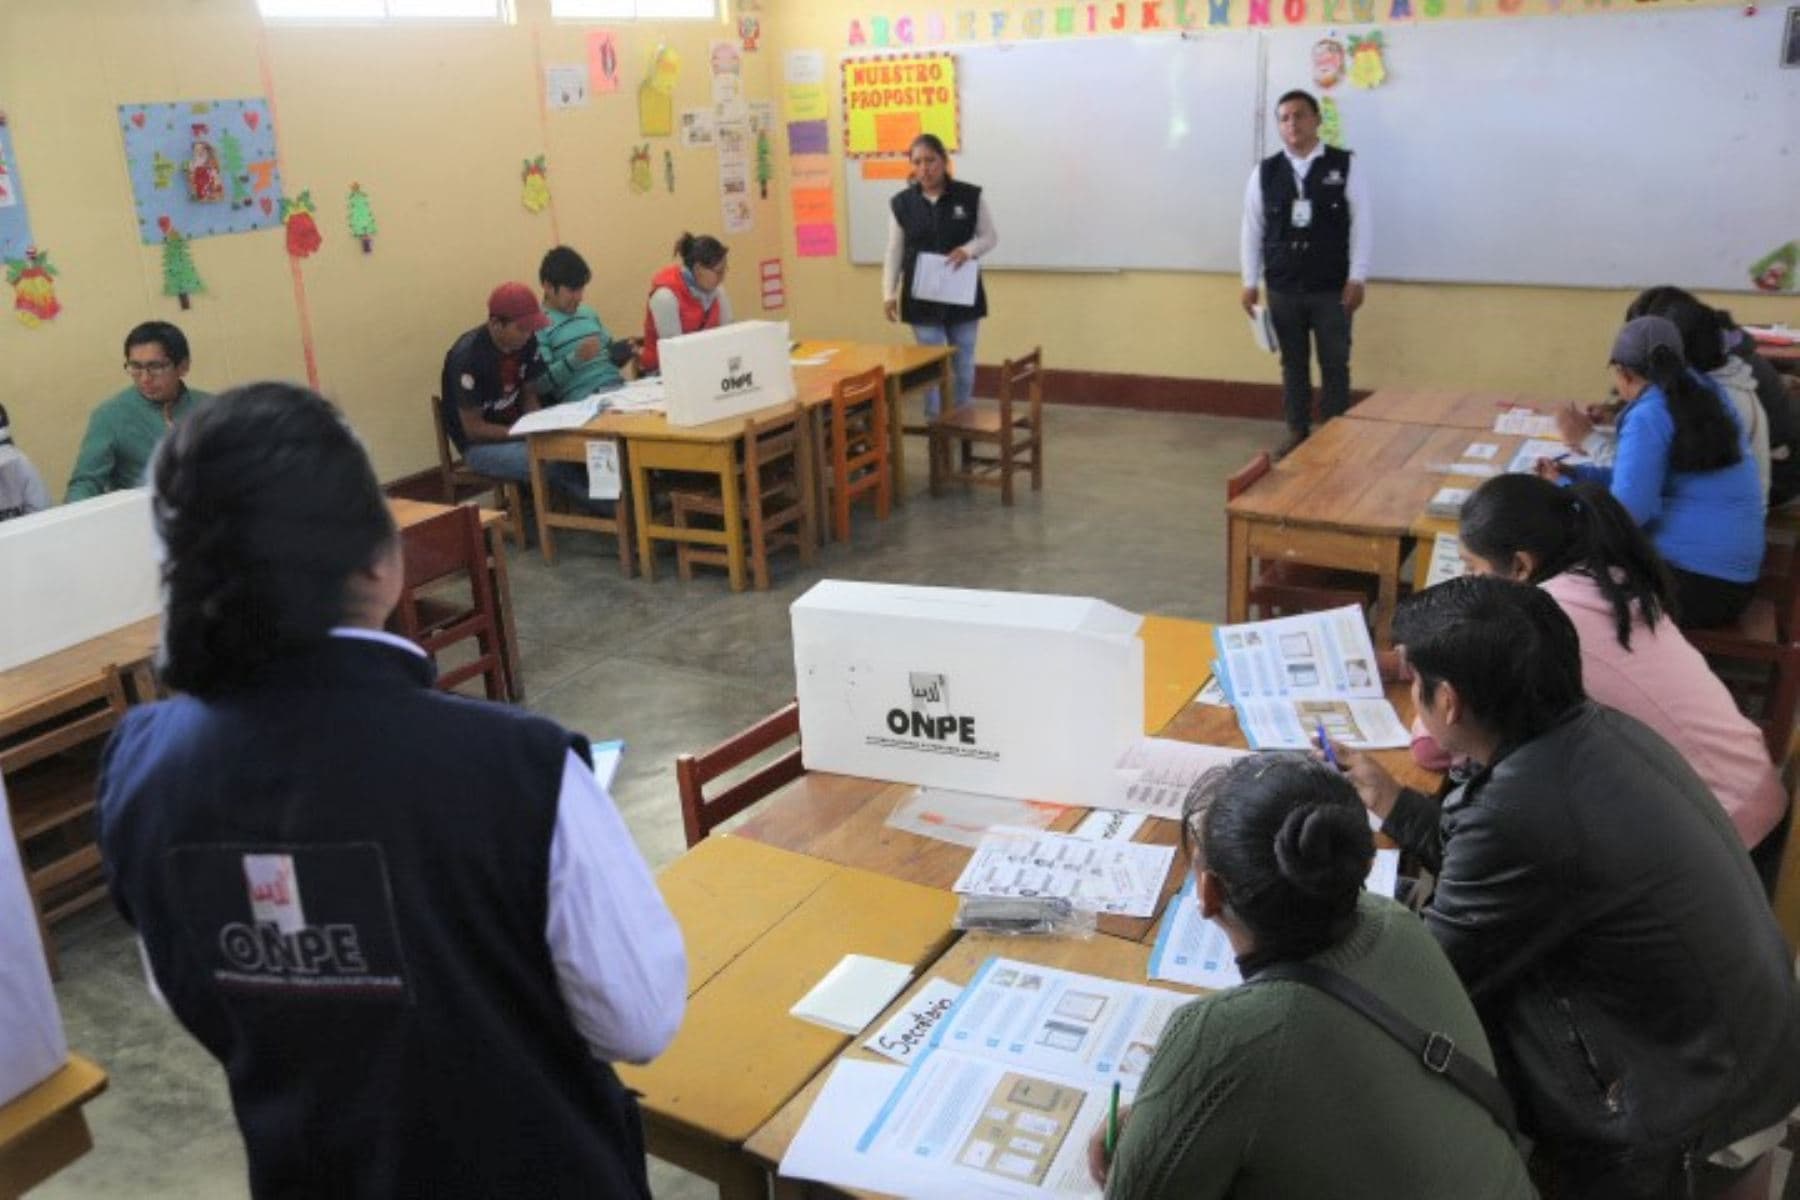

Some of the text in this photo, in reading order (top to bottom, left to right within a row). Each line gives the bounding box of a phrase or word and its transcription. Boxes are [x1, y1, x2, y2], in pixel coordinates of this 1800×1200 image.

[848, 19, 866, 46] A
[895, 15, 914, 45] C
[1088, 4, 1098, 32] I
[1110, 2, 1126, 29] J
[1141, 1, 1160, 29] K
[1283, 0, 1307, 24] O
[853, 63, 943, 86] NUESTRO
[850, 86, 950, 110] PROPOSITO
[721, 372, 753, 392] ONPE
[886, 708, 976, 745] ONPE
[219, 921, 368, 974] ONPE
